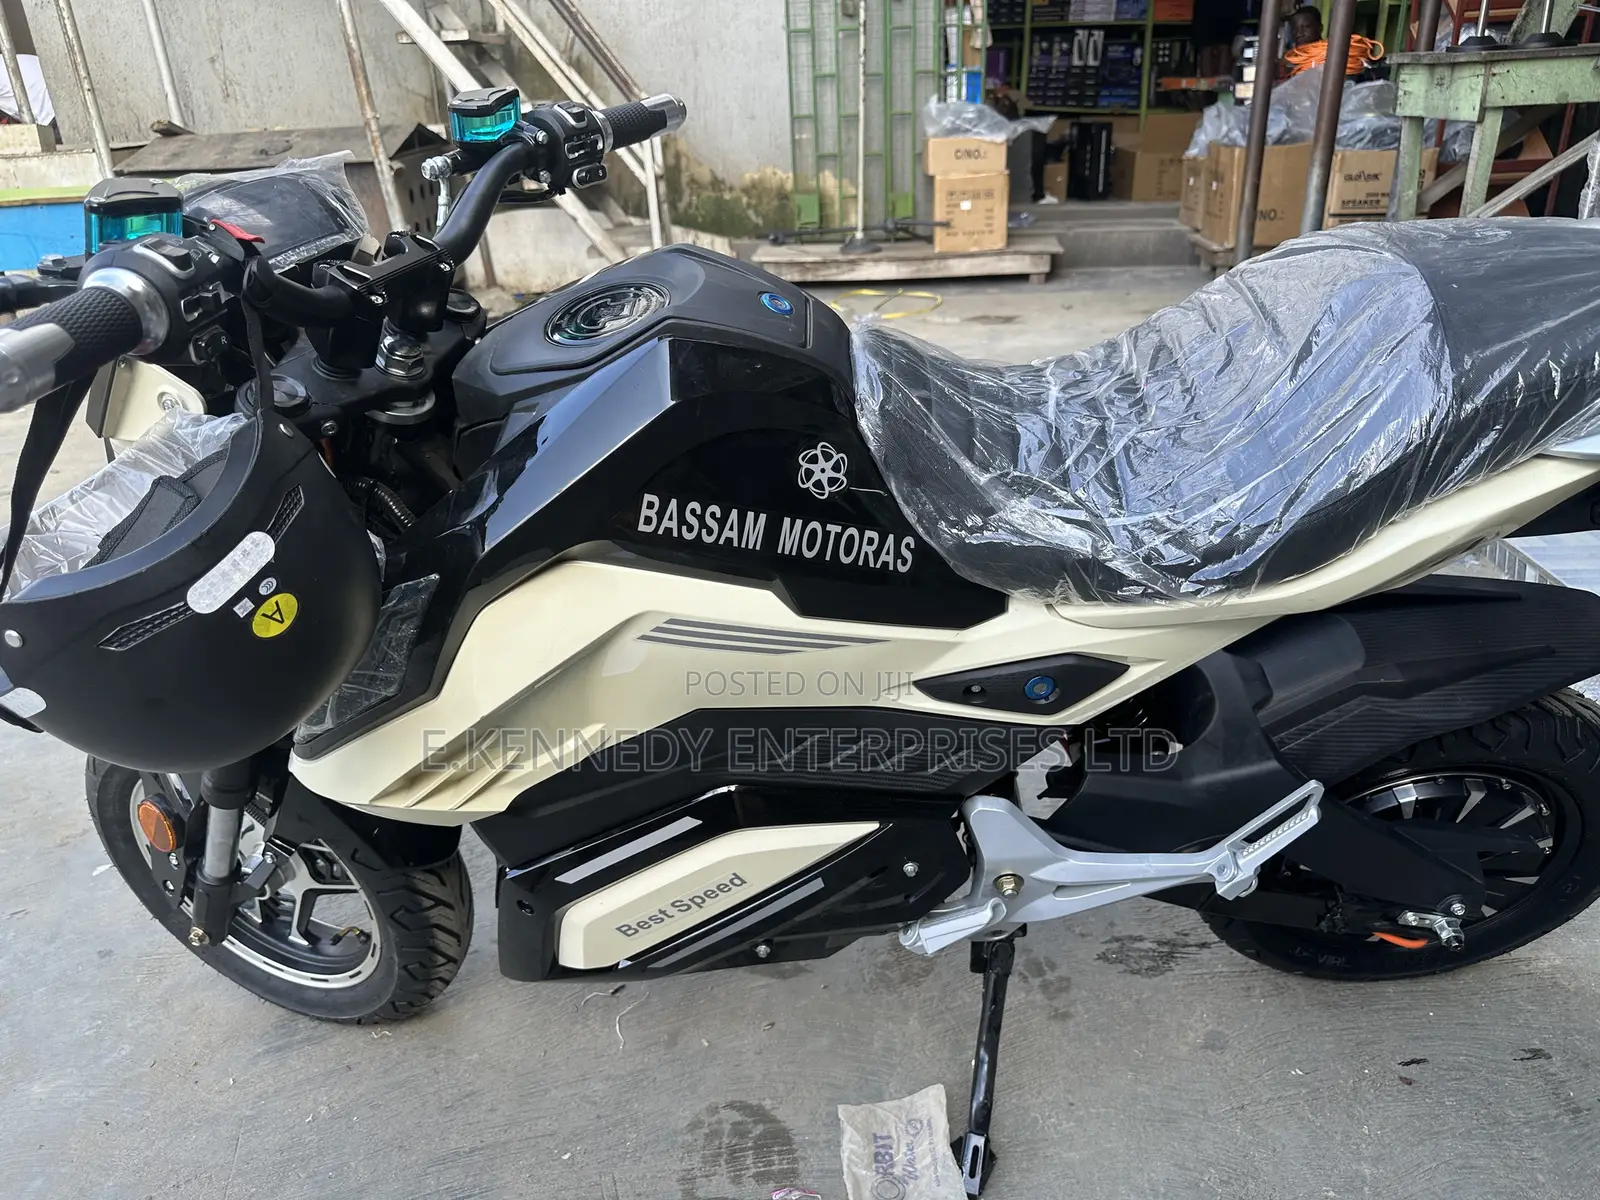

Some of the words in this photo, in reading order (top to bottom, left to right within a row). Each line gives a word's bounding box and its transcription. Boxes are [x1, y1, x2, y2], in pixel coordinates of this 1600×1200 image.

[637, 493, 767, 551] BASSAM
[777, 517, 915, 573] MOTORAS
[615, 908, 675, 937] Best
[670, 872, 748, 909] Speed
